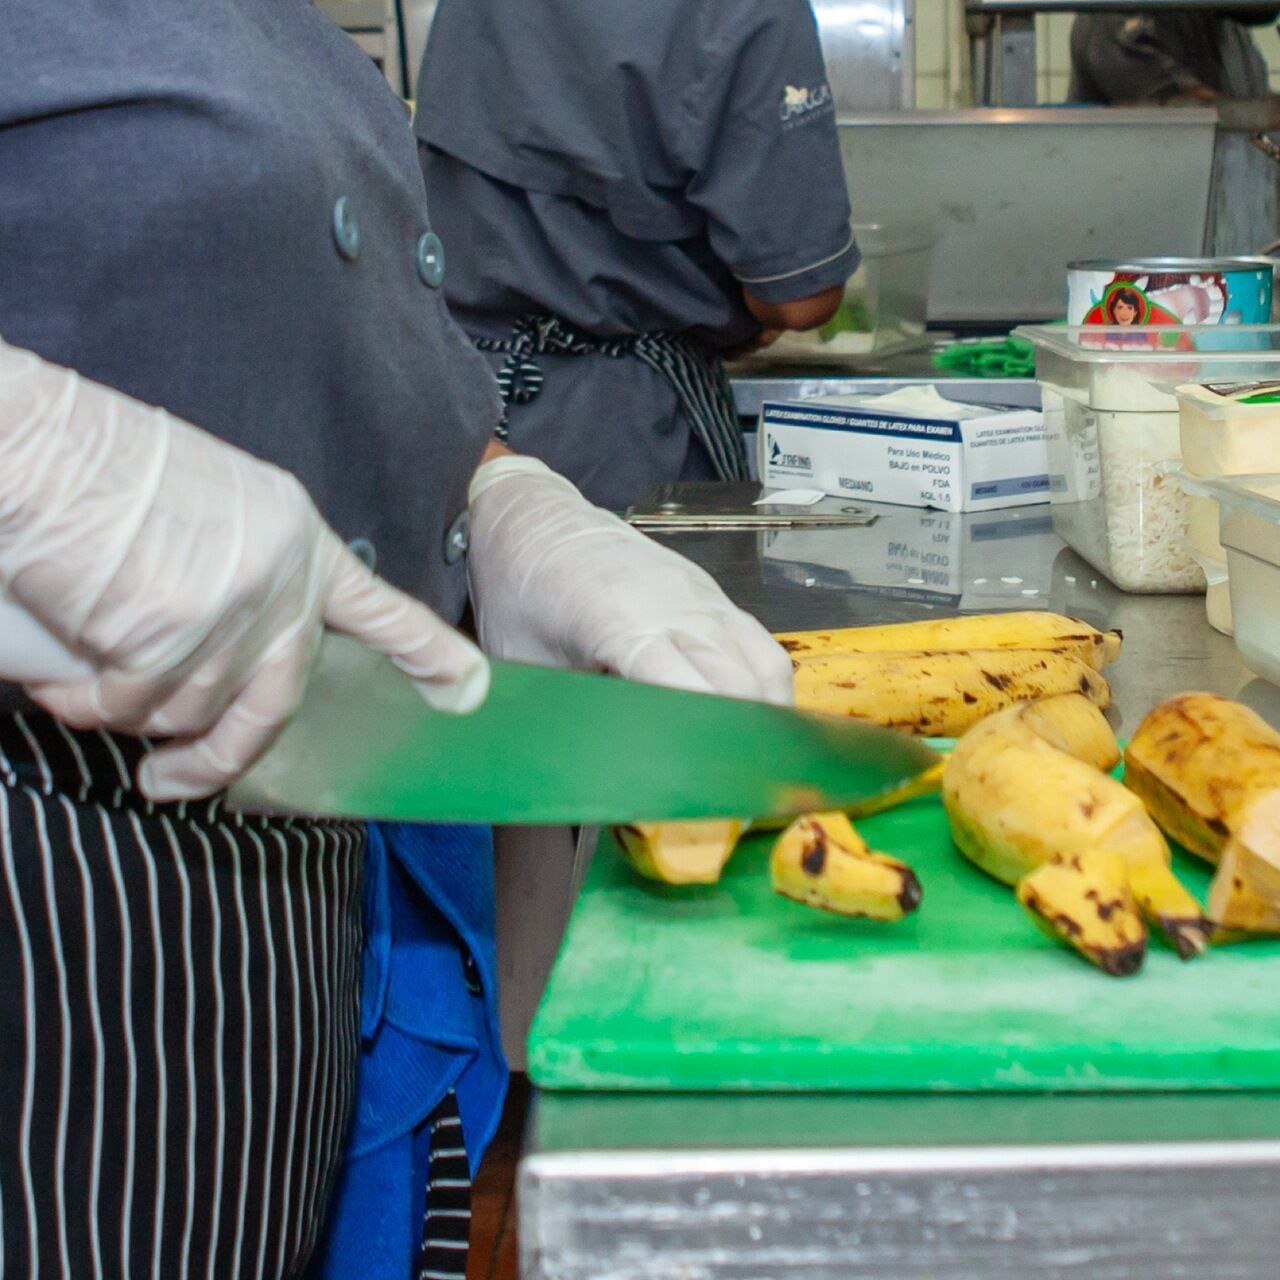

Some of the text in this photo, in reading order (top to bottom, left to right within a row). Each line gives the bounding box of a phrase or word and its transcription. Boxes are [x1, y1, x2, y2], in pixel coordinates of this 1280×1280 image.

[879, 421, 888, 429] DE
[888, 422, 908, 431] LATEX
[887, 446, 904, 456] Para
[906, 448, 920, 458] Uso
[889, 460, 951, 475] BAJO en POLVO
[838, 477, 874, 493] MEDIANO
[932, 479, 950, 488] FDA
[938, 492, 951, 502] 1.5
